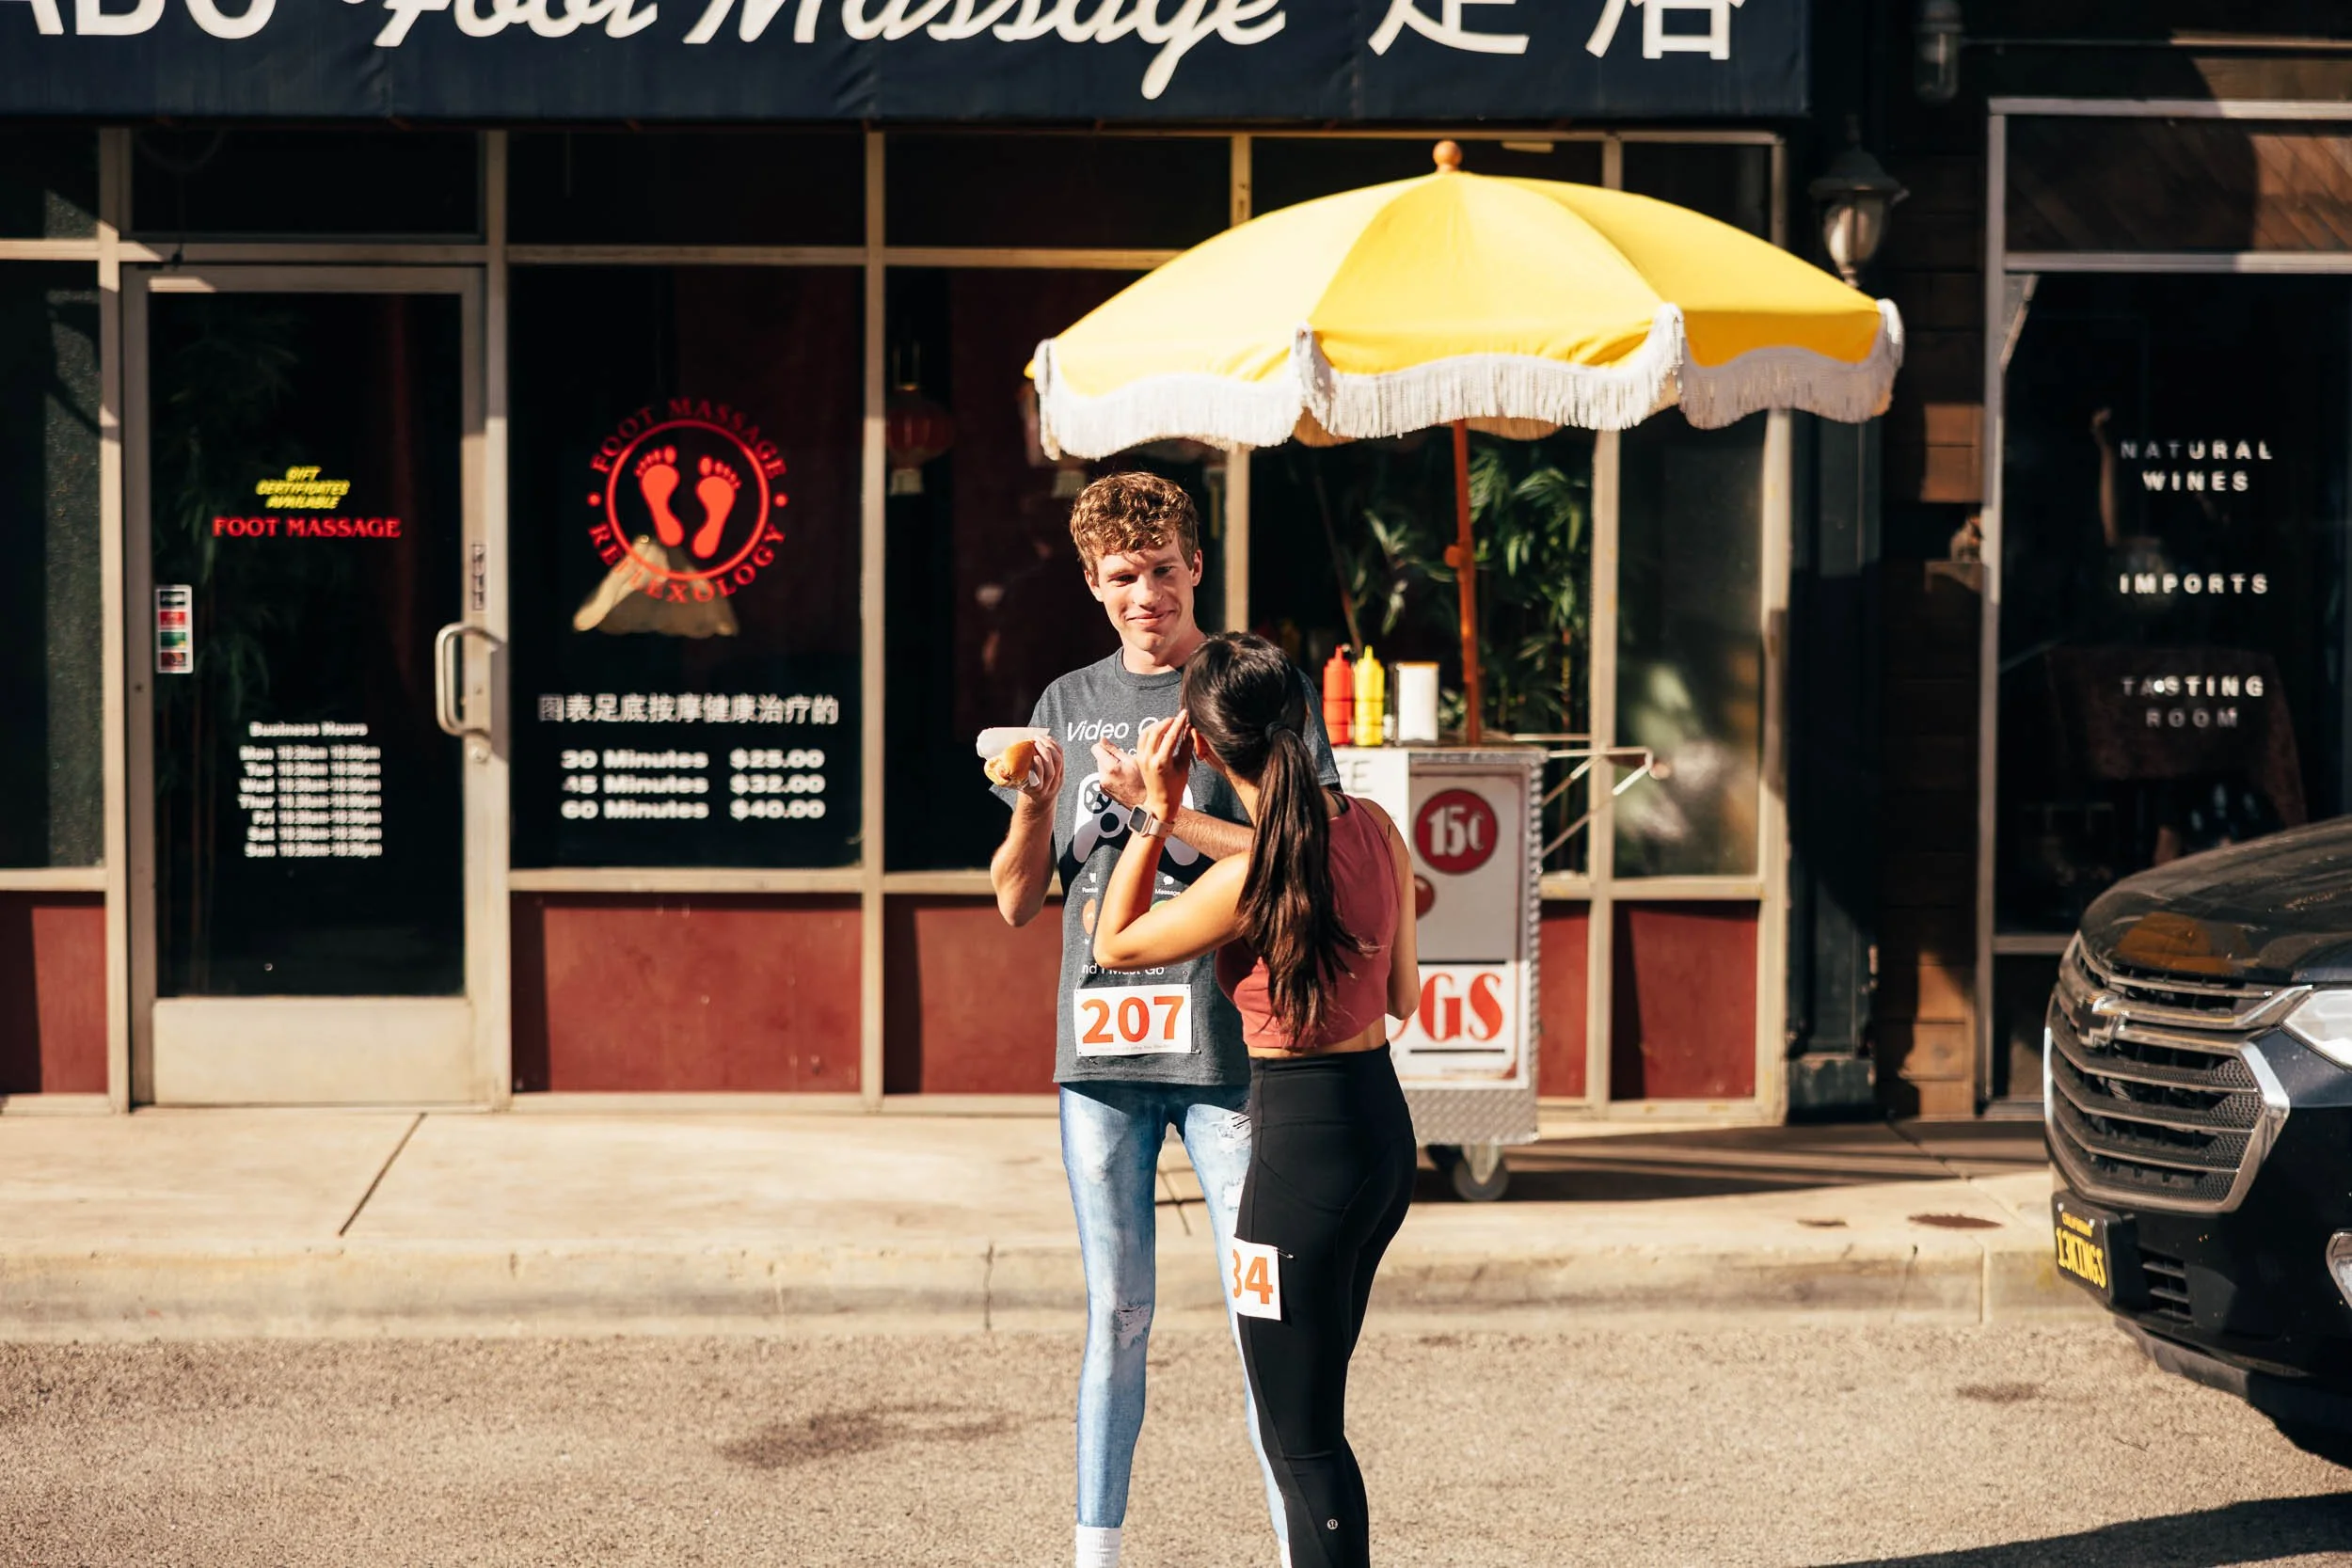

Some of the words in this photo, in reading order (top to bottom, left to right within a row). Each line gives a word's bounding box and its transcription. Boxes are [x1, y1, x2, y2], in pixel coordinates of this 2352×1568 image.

[589, 405, 655, 474] FOOT
[667, 396, 787, 481] MASSAGE
[2121, 439, 2273, 460] NATURAL
[2142, 470, 2249, 491] WINES
[212, 516, 280, 538] FOOT
[286, 516, 402, 538] MASSAGE
[2120, 573, 2268, 594] IMPORTS
[2121, 675, 2264, 697] TASTING
[2146, 706, 2238, 728] ROOM
[1067, 720, 1130, 742] Video
[561, 750, 598, 770] 30
[602, 749, 709, 770] Minutes
[729, 748, 826, 770] $25.00
[561, 774, 598, 795] 45
[602, 773, 709, 795] Minutes
[729, 772, 826, 795] $32.00
[561, 800, 598, 820] 60
[602, 799, 709, 820] Minutes
[729, 798, 826, 820] $40.00
[1082, 962, 1098, 974] nd
[1391, 972, 1503, 1043] GS
[1081, 996, 1184, 1044] 207
